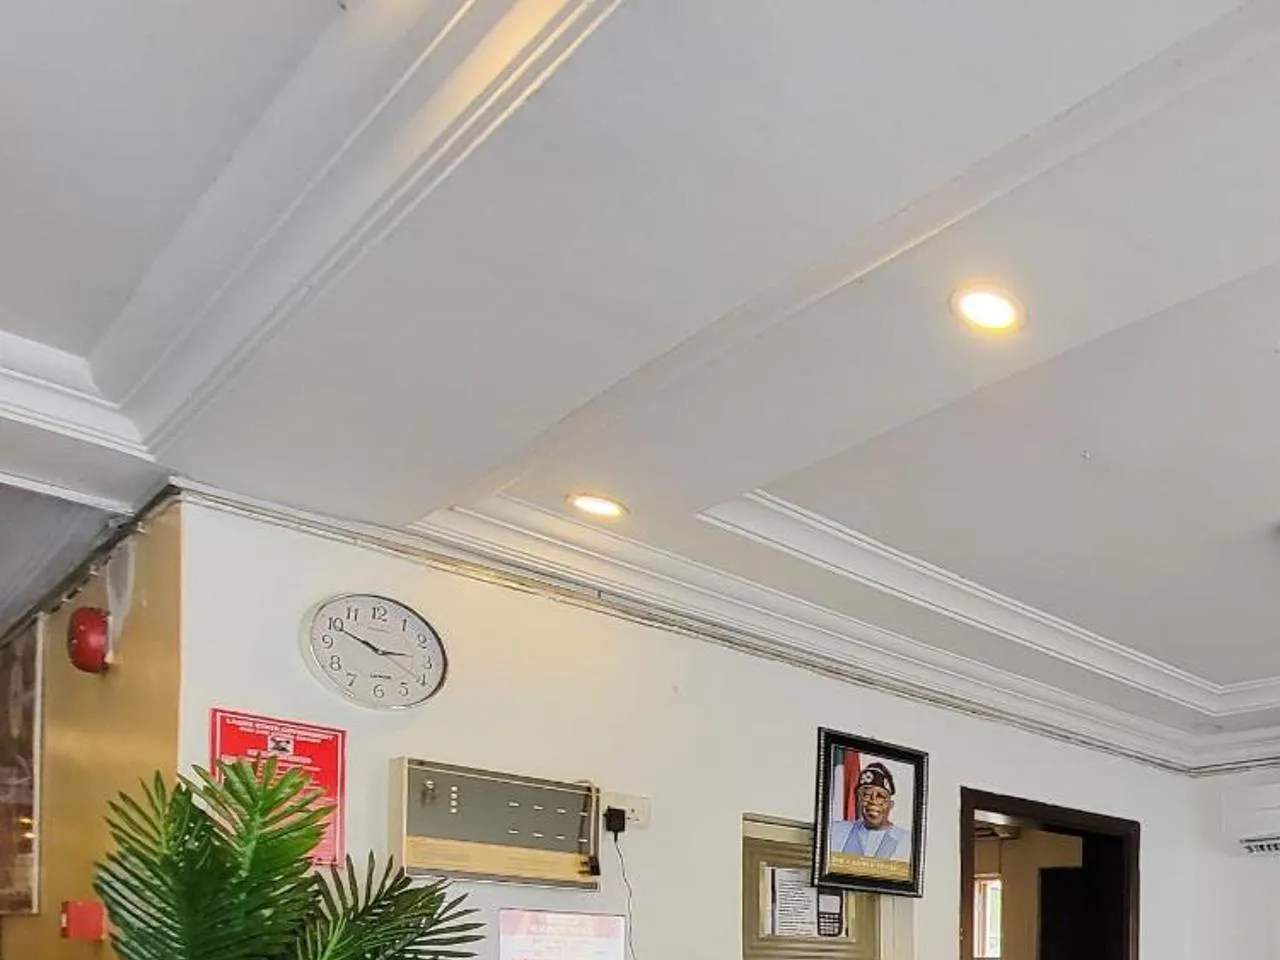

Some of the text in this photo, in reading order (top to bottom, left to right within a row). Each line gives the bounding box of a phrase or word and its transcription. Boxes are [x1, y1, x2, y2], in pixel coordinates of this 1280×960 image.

[346, 606, 359, 622] 11
[371, 606, 387, 622] 12
[328, 616, 343, 632] 10
[401, 619, 407, 631] 1
[322, 634, 333, 649] 9
[417, 633, 427, 649] 2
[329, 655, 341, 671] 8
[424, 656, 432, 669] 3
[346, 672, 357, 686] 7
[416, 674, 426, 686] 4
[373, 684, 385, 698] 6
[398, 681, 408, 697] 5
